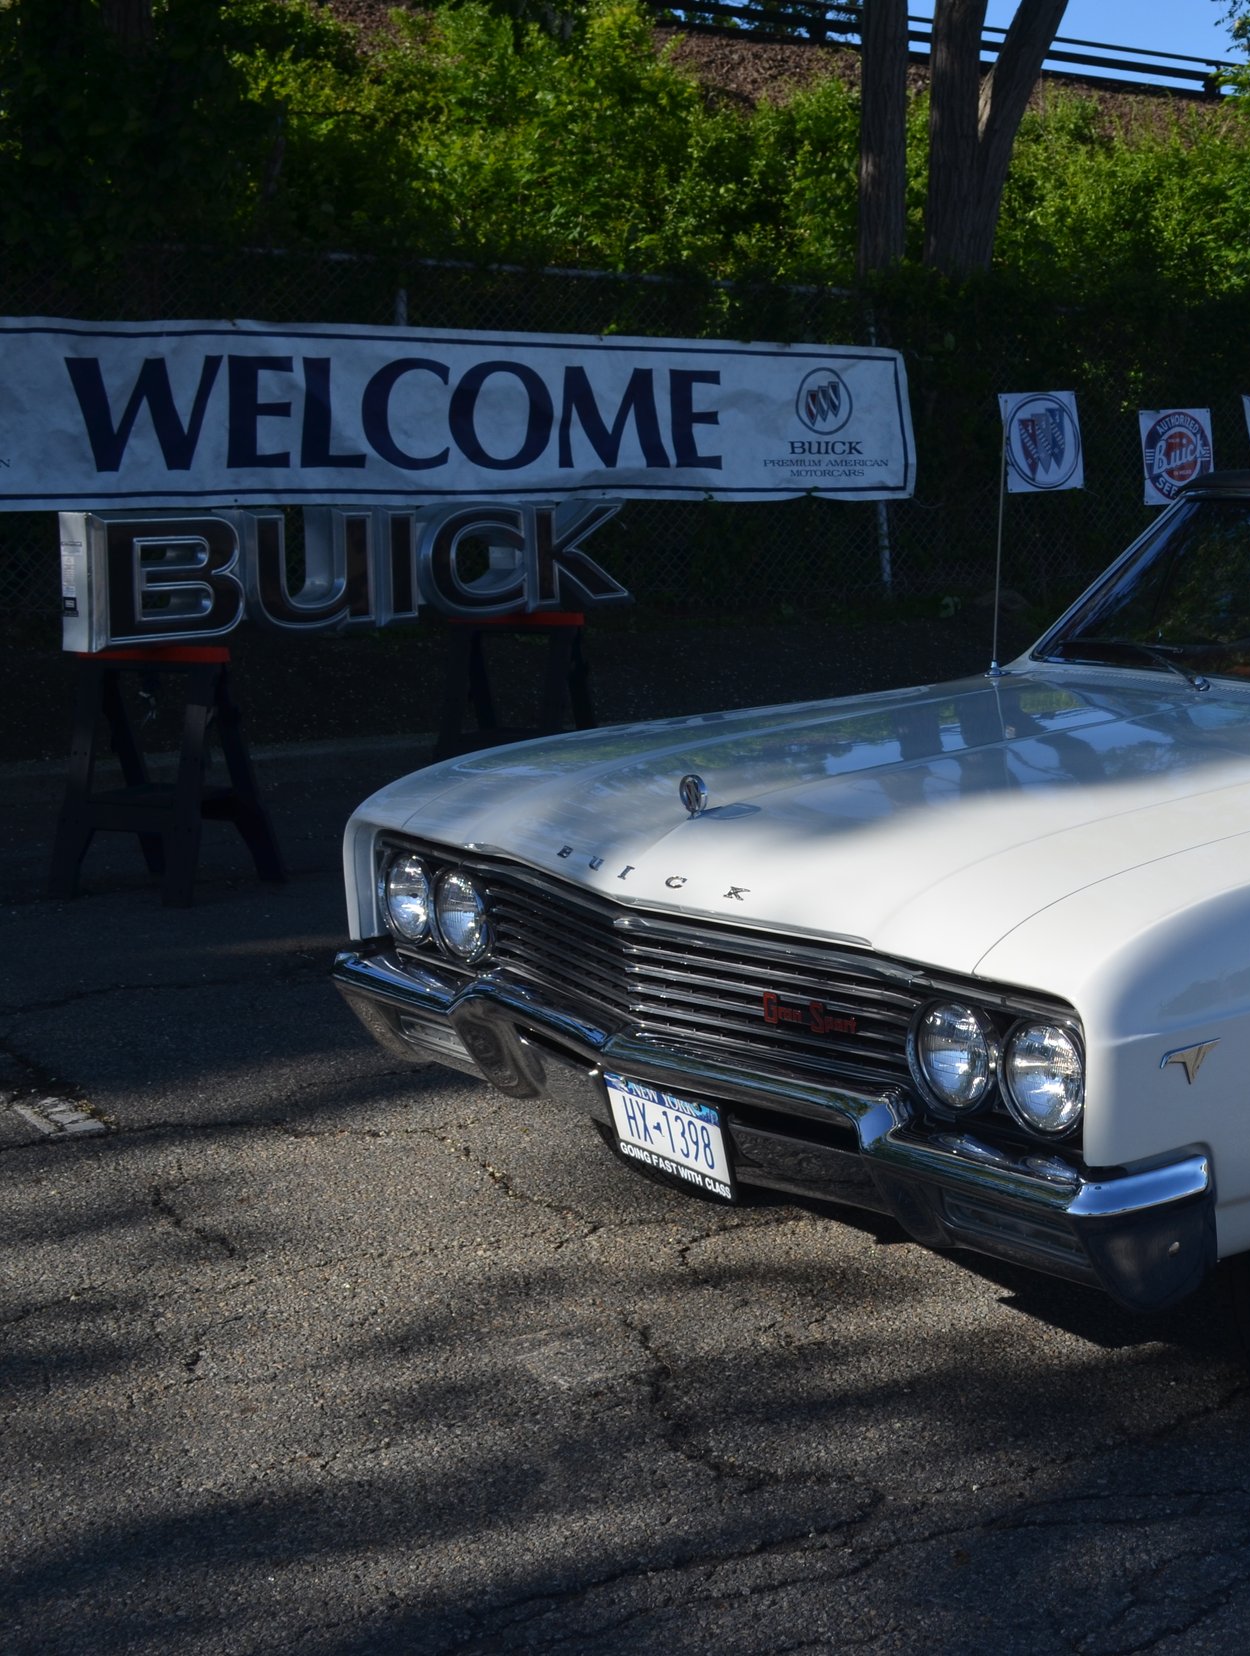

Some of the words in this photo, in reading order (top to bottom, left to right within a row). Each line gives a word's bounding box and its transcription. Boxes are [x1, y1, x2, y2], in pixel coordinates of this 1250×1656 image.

[64, 354, 724, 473] WELCOME
[1156, 414, 1200, 435] AUTHORIZED
[763, 459, 822, 468] PREMIUM
[825, 459, 889, 467] AMERICAN
[788, 440, 864, 455] BUICK
[1153, 434, 1206, 475] Buick
[790, 469, 865, 478] MOTORCARS
[100, 504, 632, 648] BUICK
[556, 845, 751, 901] BUICK
[633, 1084, 659, 1103] NEW
[661, 1092, 697, 1118] YORK
[622, 1096, 654, 1145] HX
[662, 1110, 715, 1170] 1398
[620, 1142, 652, 1164] GOING
[651, 1155, 678, 1175] FAST
[677, 1166, 703, 1186] WITH
[704, 1177, 732, 1200] CLASS
